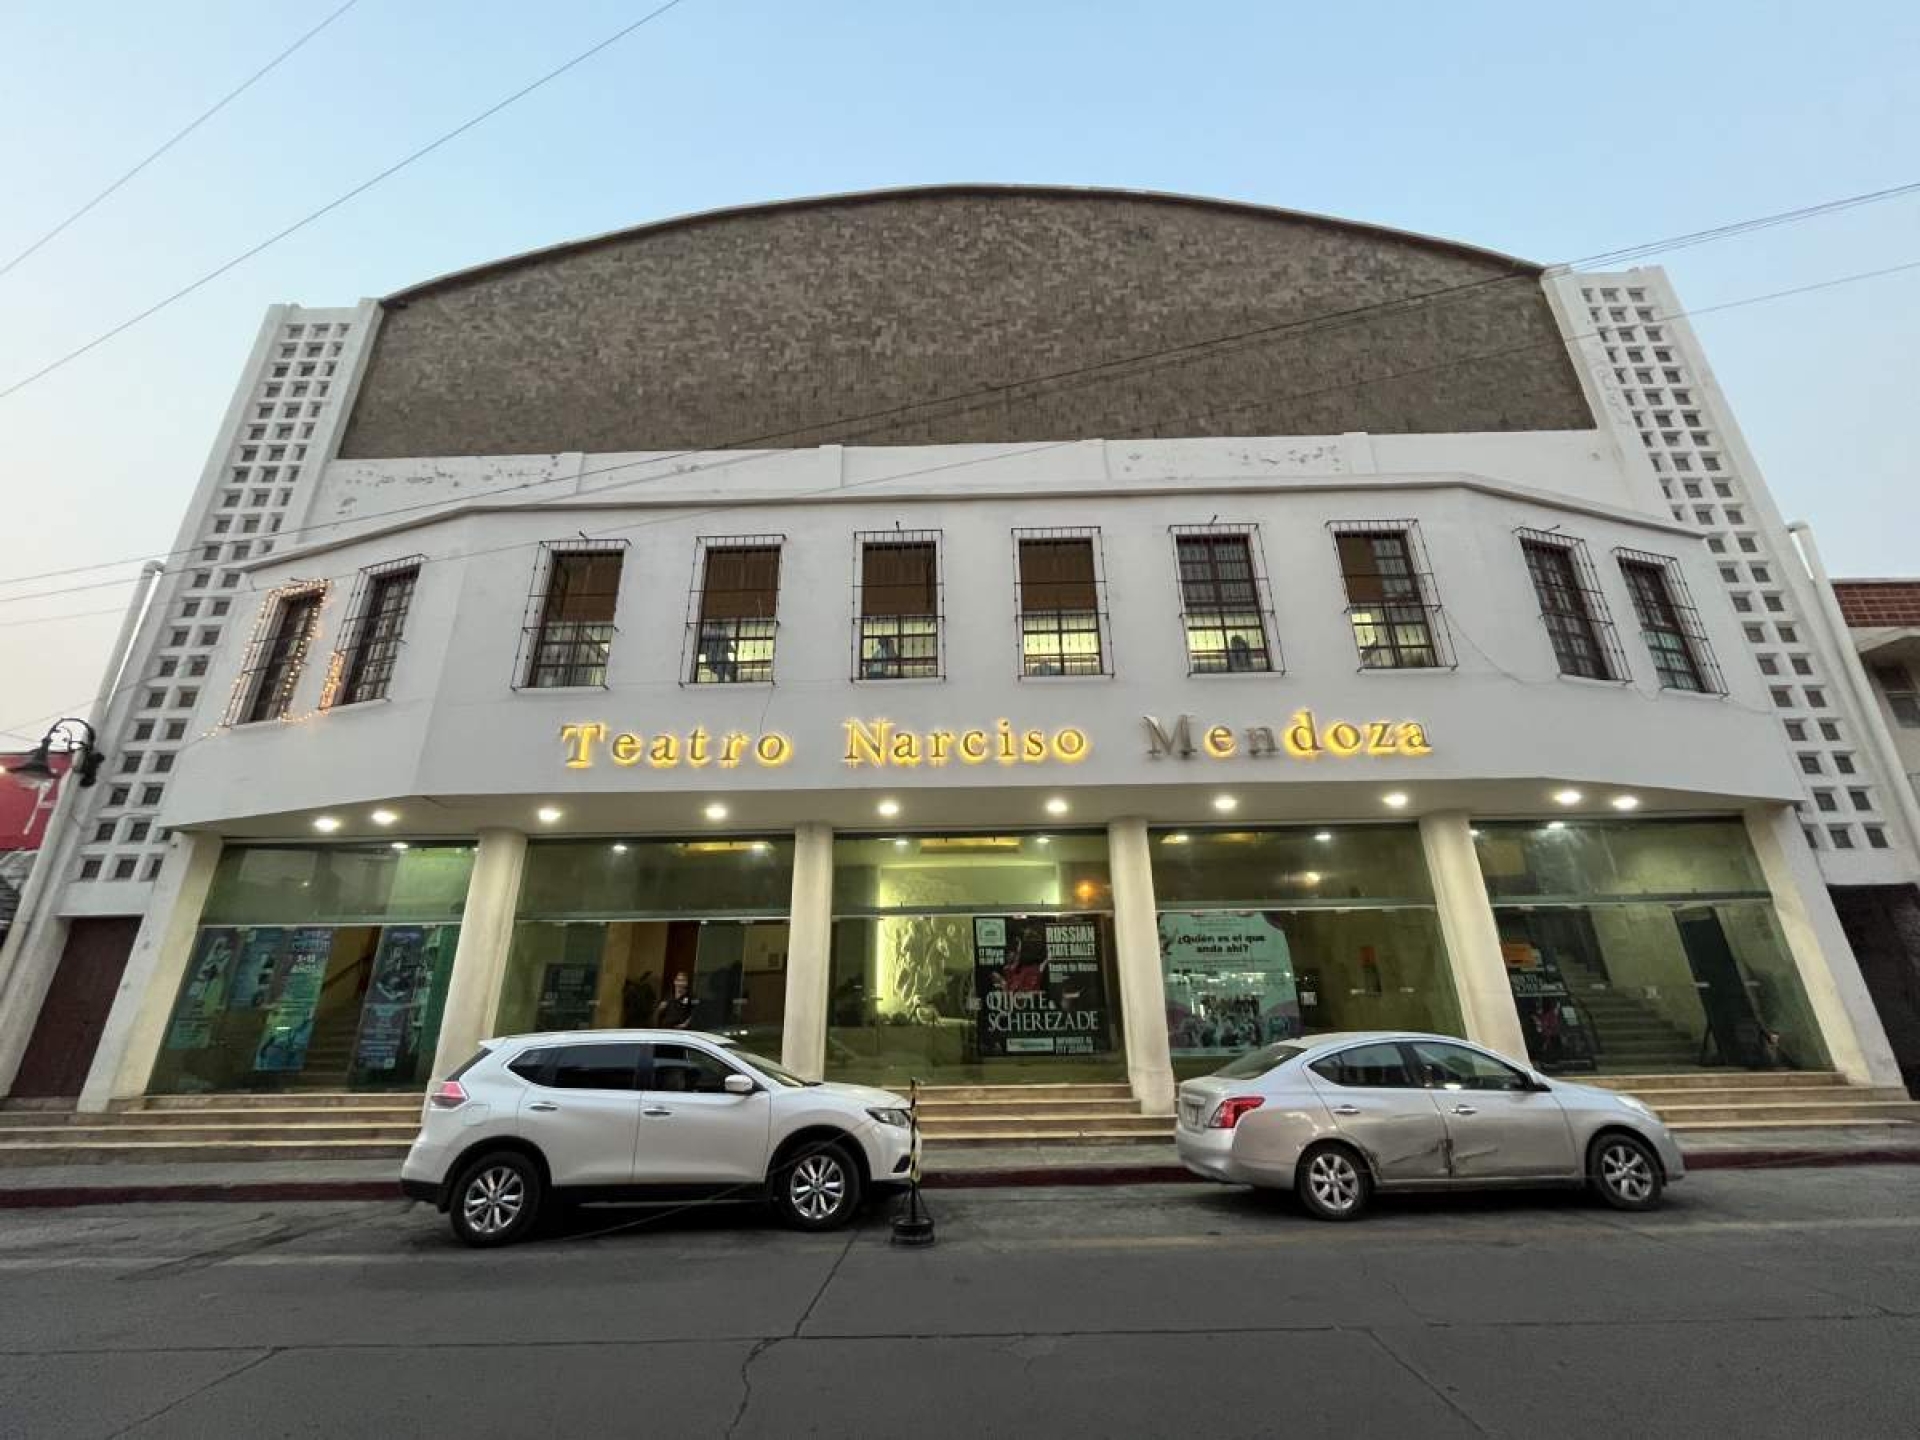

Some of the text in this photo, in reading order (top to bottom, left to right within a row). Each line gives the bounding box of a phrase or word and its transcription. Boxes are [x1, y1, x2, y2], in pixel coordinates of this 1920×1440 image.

[560, 707, 1433, 768] Teatro Narciso Mendoza
[1045, 925, 1095, 943] RUSSIAN
[1217, 935, 1229, 943] es
[1231, 934, 1242, 943] el
[1245, 935, 1266, 945] que
[1196, 944, 1223, 953] anda
[988, 1011, 1100, 1032] SCHEREZADE
